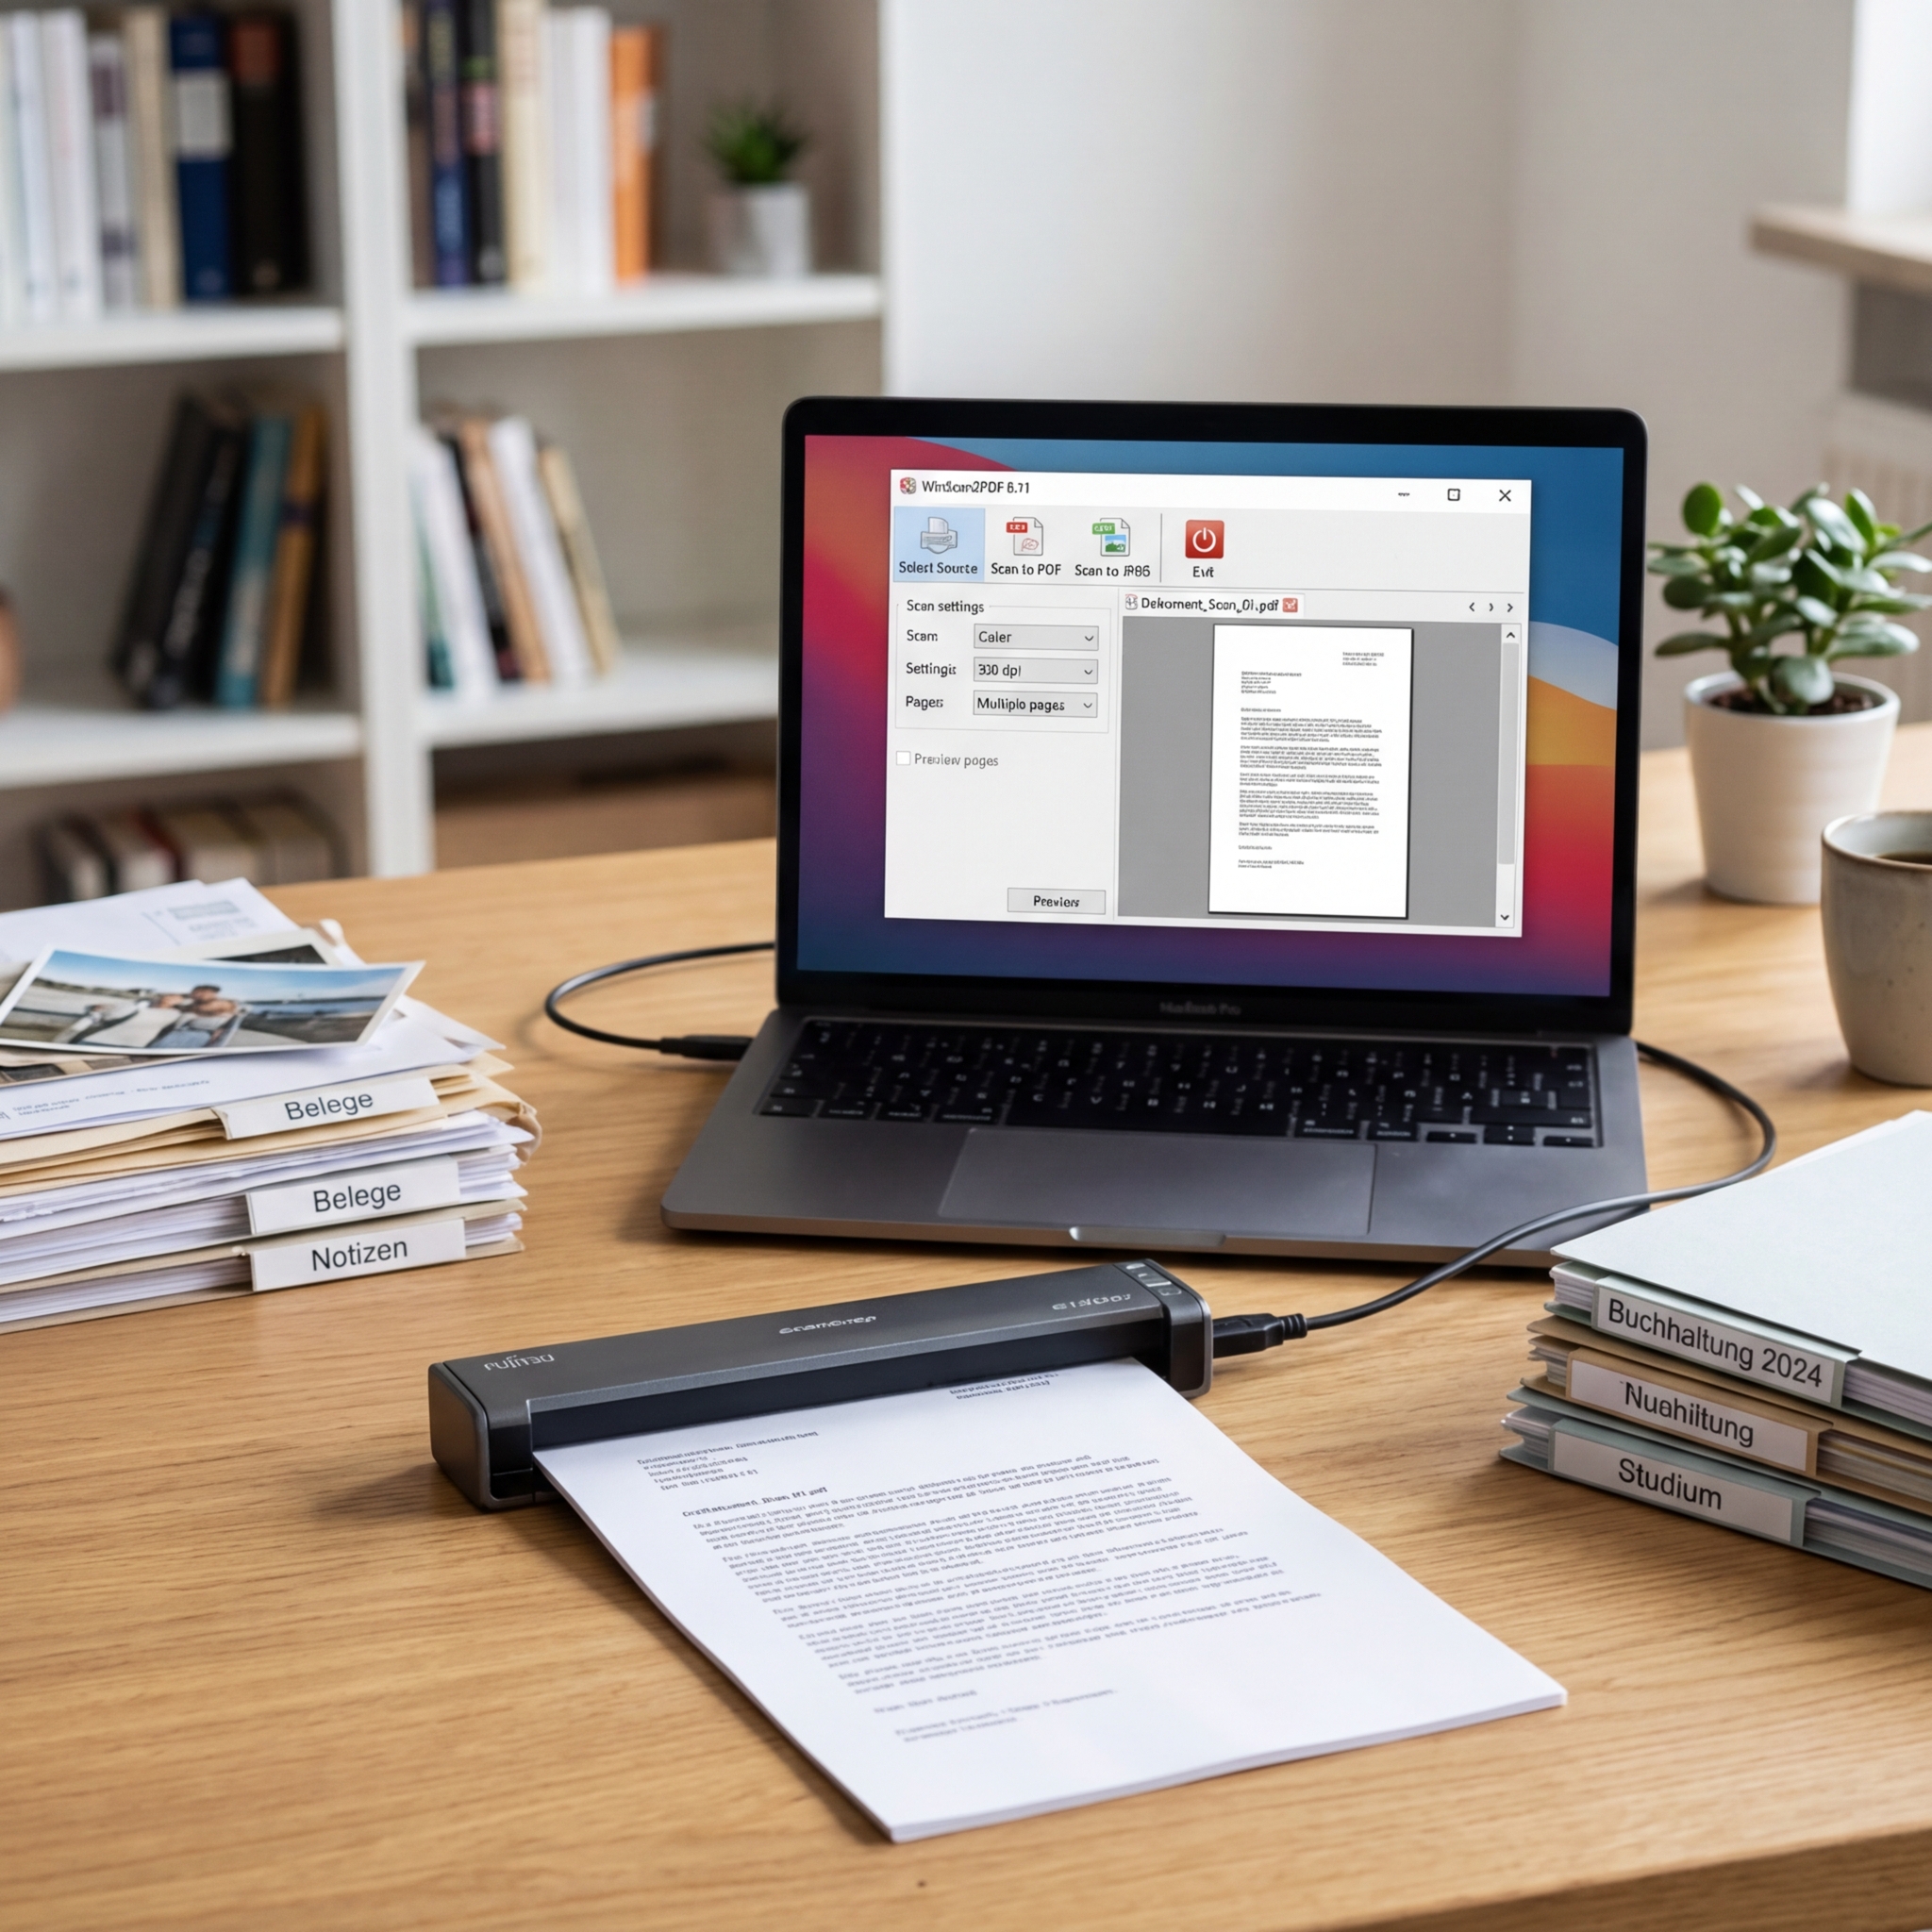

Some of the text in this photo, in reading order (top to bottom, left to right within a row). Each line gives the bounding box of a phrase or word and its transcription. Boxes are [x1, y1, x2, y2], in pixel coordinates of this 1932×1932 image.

[991, 561, 1019, 575] Scan
[1022, 563, 1035, 575] to
[1074, 563, 1103, 576] Scan
[1106, 566, 1120, 577] to
[907, 598, 985, 616] Scan settings
[1029, 701, 1065, 714] pages
[285, 1091, 375, 1122] Belege
[312, 1180, 402, 1213] Belege
[311, 1238, 408, 1273] Notizen
[1607, 1298, 1824, 1389] Buchhaltung 2024
[1618, 1457, 1723, 1510] Studium
